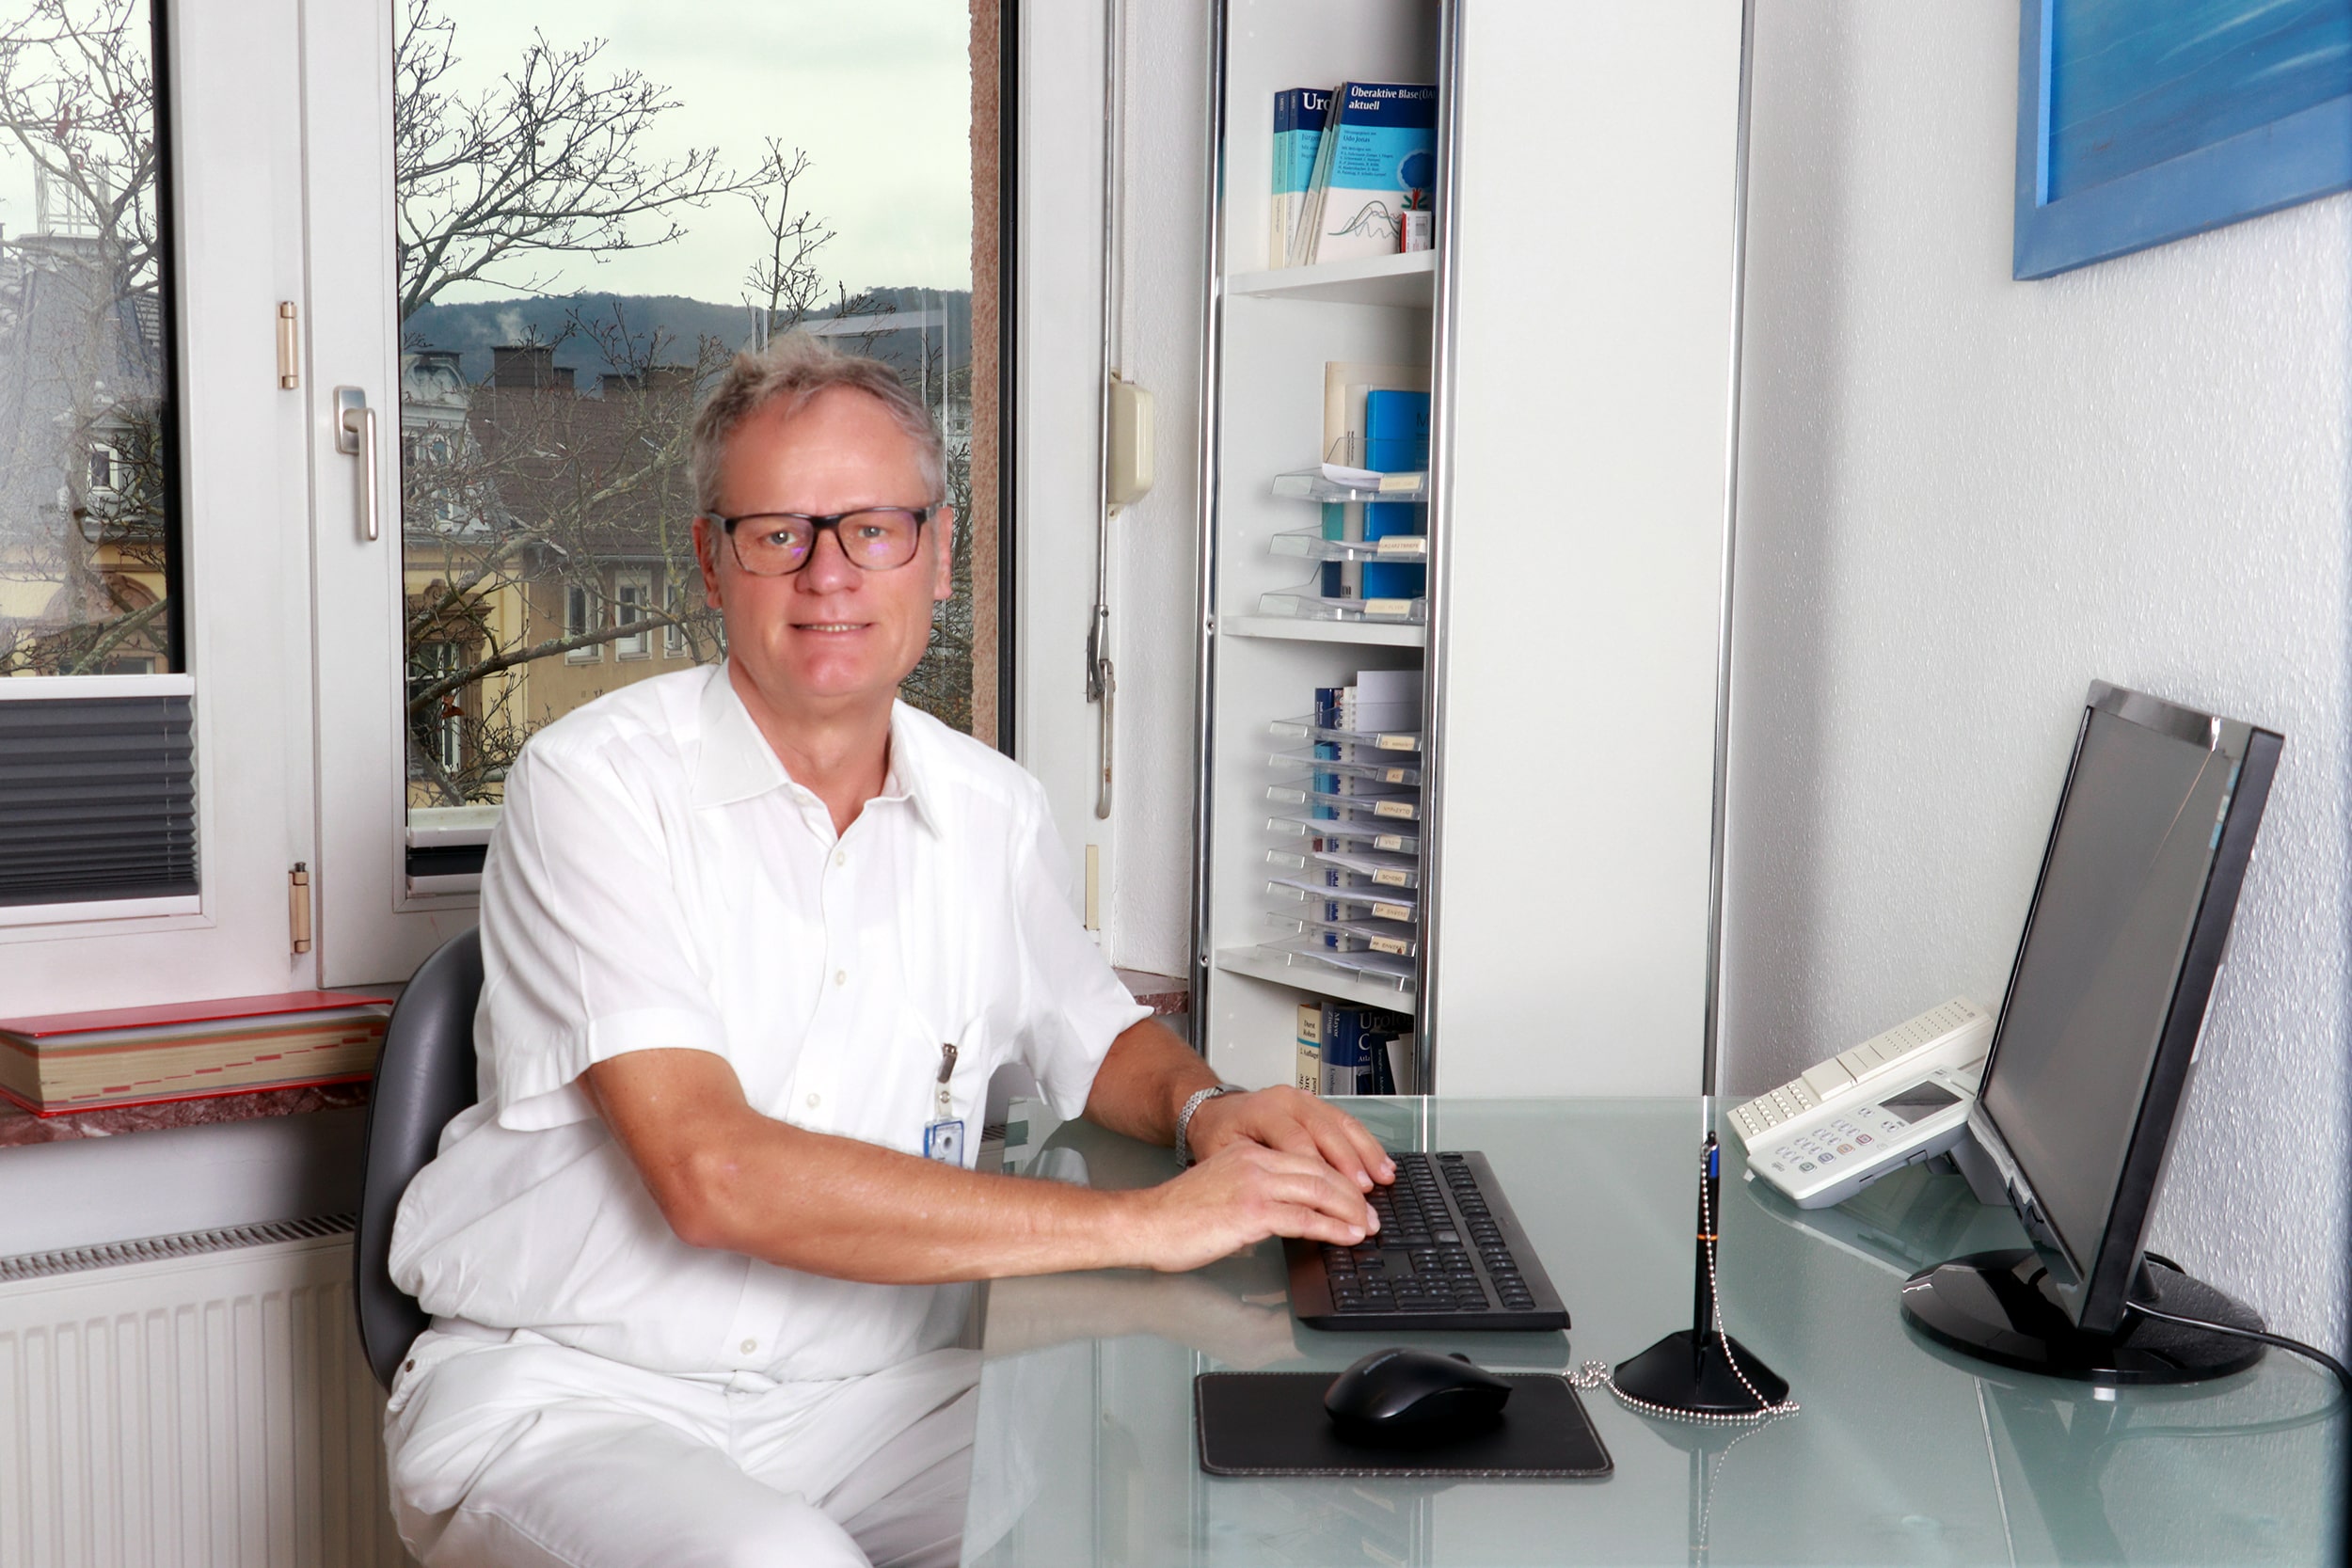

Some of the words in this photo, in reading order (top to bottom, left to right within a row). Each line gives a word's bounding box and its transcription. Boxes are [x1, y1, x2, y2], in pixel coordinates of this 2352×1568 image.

[1351, 86, 1397, 99] Überaktive
[1398, 89, 1420, 100] Blase
[1348, 100, 1380, 110] aktuell
